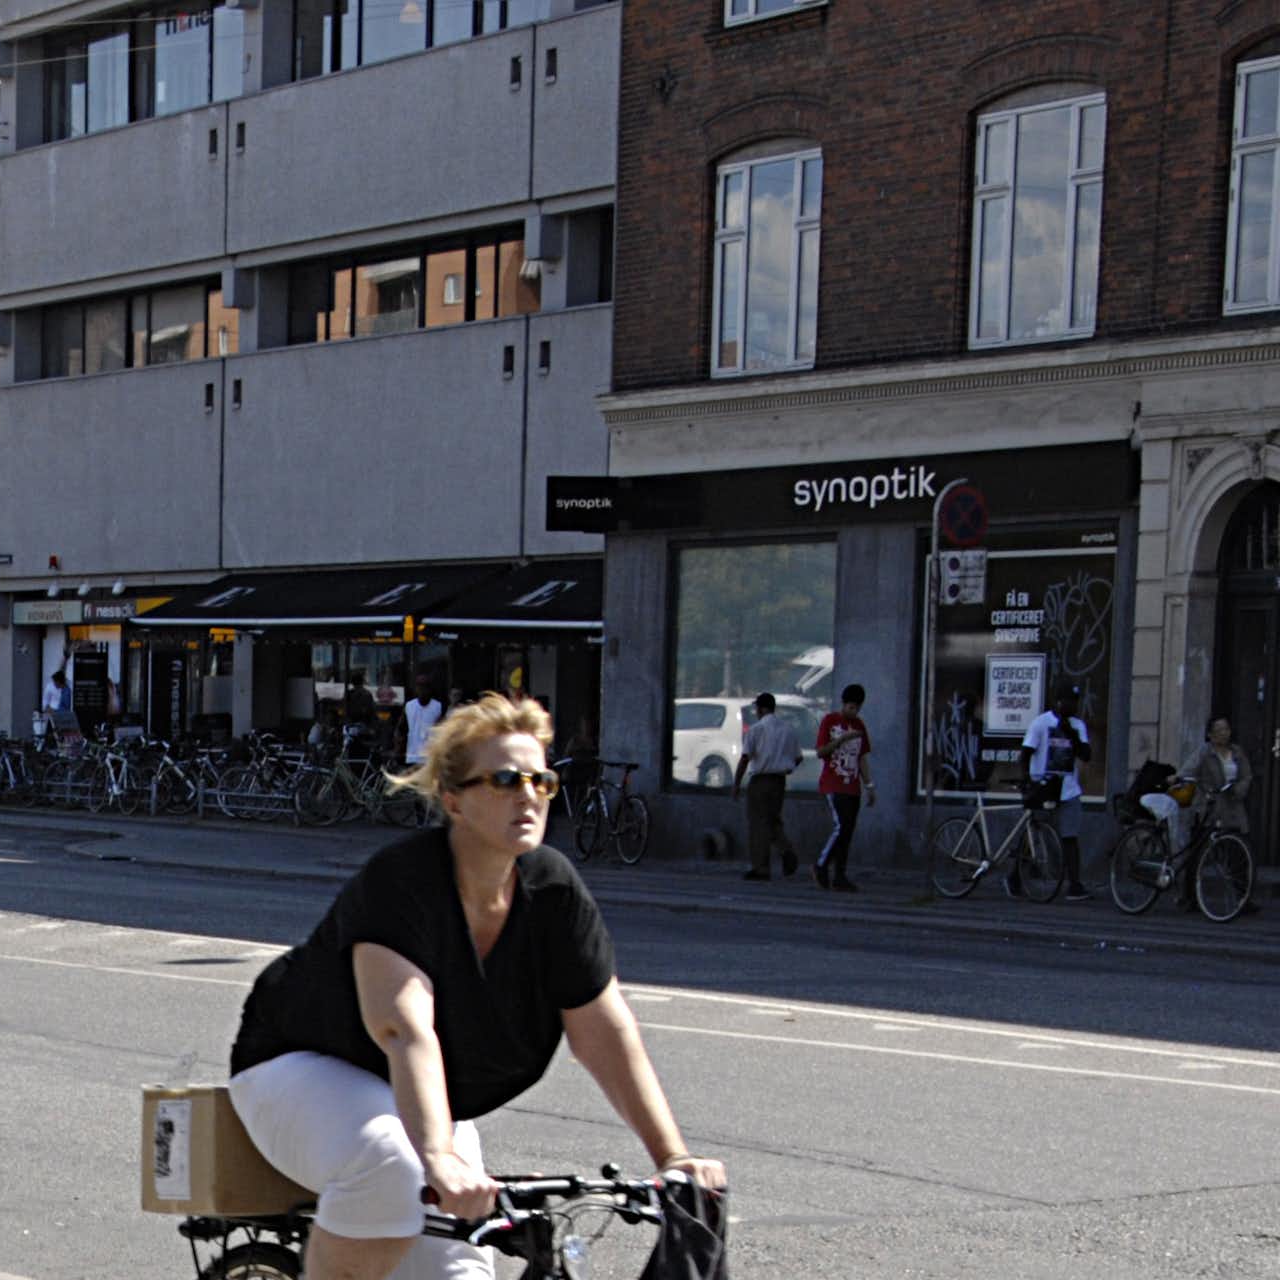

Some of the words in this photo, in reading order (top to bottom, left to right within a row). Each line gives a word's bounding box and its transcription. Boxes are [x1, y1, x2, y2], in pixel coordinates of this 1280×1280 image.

[793, 465, 937, 512] synoptik
[555, 496, 613, 511] synoptik
[991, 609, 1044, 626] CERTIFICERET
[992, 666, 1038, 681] CERTIFICERET
